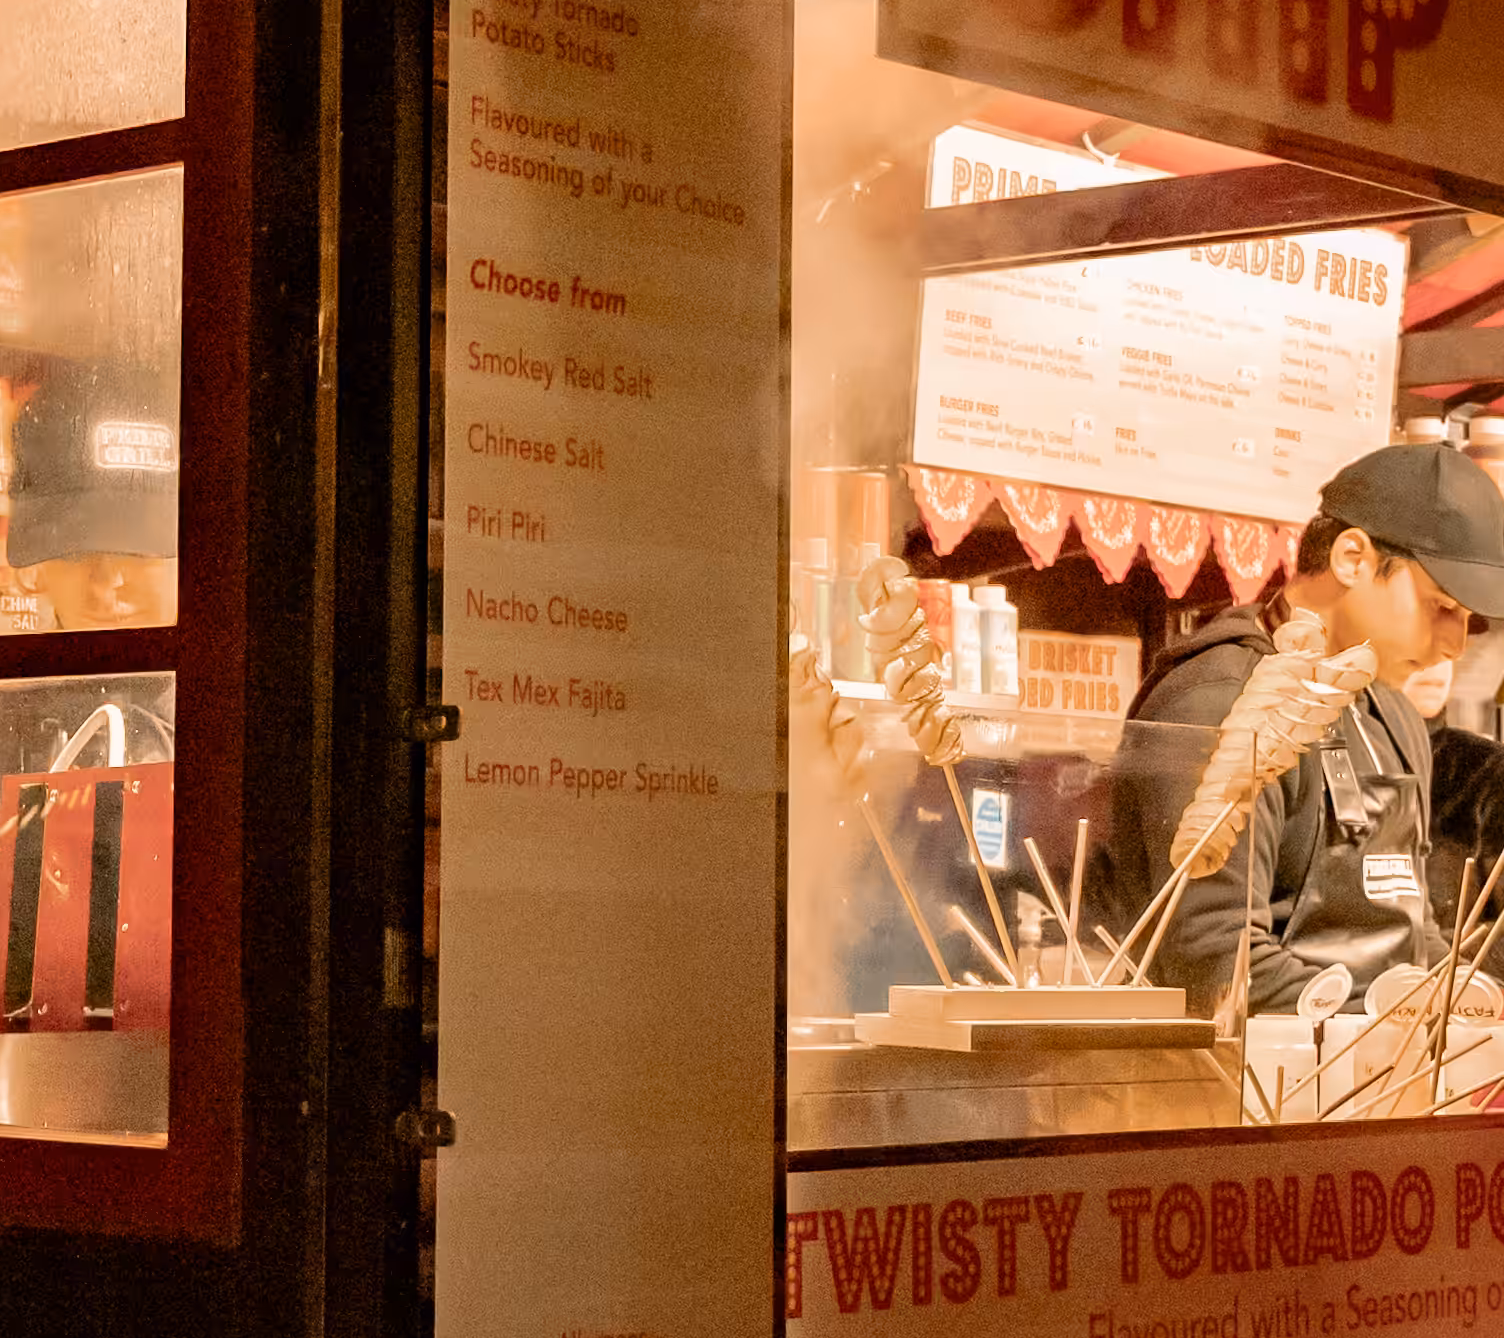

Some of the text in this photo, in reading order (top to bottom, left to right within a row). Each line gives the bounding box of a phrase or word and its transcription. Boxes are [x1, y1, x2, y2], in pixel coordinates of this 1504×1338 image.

[472, 9, 615, 73] Potato Sticks
[471, 95, 653, 164] Flavoured with a
[470, 138, 744, 225] Seasoning of your Choice
[470, 259, 626, 316] Choose from
[1314, 249, 1388, 306] FRIES
[468, 342, 653, 399] Smokey Red Salt
[468, 423, 605, 471] Chinese Salt
[467, 505, 546, 543] Piri Piri
[466, 588, 628, 632] Nacho Cheese
[1029, 641, 1117, 676] BRISKET
[464, 669, 626, 716] Tex Mex Fajita
[1062, 679, 1119, 712] FRIES
[464, 754, 718, 798] Lemon Pepper Sprinkle
[786, 1191, 1084, 1319] TWISTY
[1108, 1161, 1434, 1286] TORNADO
[1319, 1306, 1336, 1333] a
[1346, 1268, 1479, 1337] Seasoning
